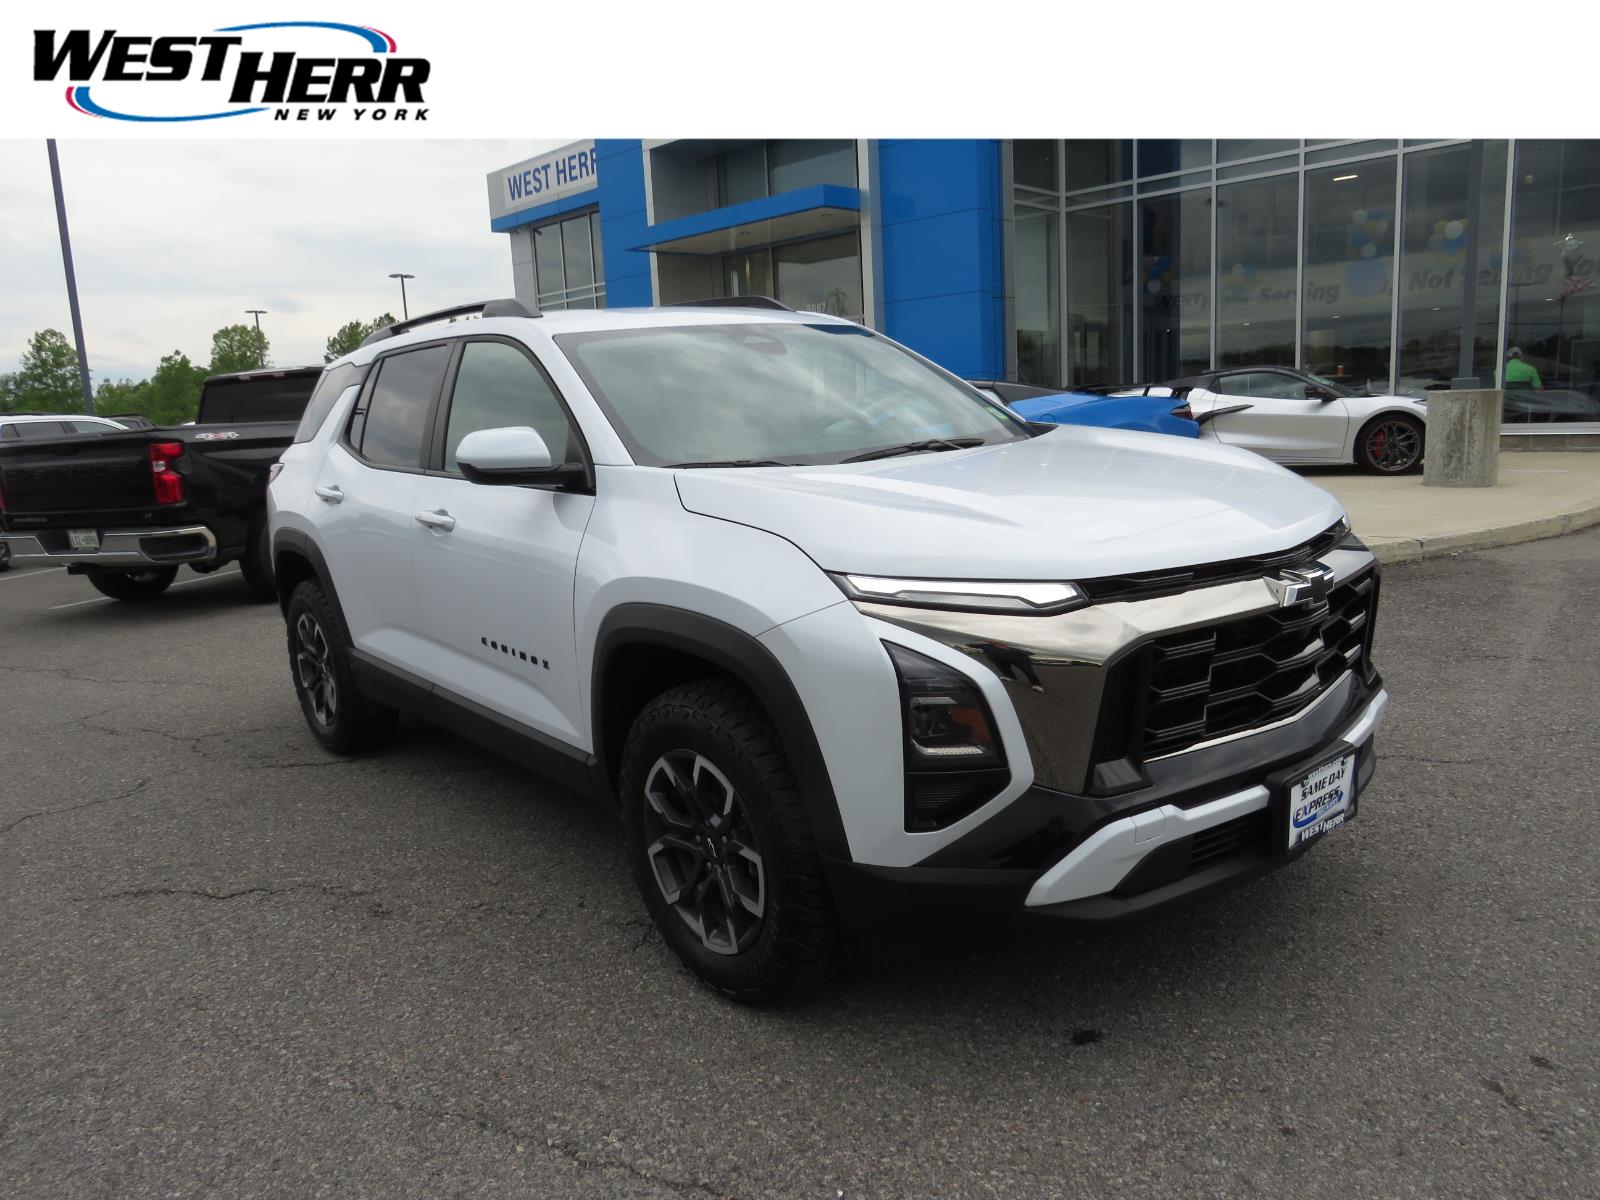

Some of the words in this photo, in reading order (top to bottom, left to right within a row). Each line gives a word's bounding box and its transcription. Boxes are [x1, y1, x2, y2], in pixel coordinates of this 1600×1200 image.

[508, 163, 551, 200] WEST
[1301, 775, 1328, 801] SAME
[1328, 767, 1346, 787] DAY
[1295, 785, 1341, 821] EXPRESS
